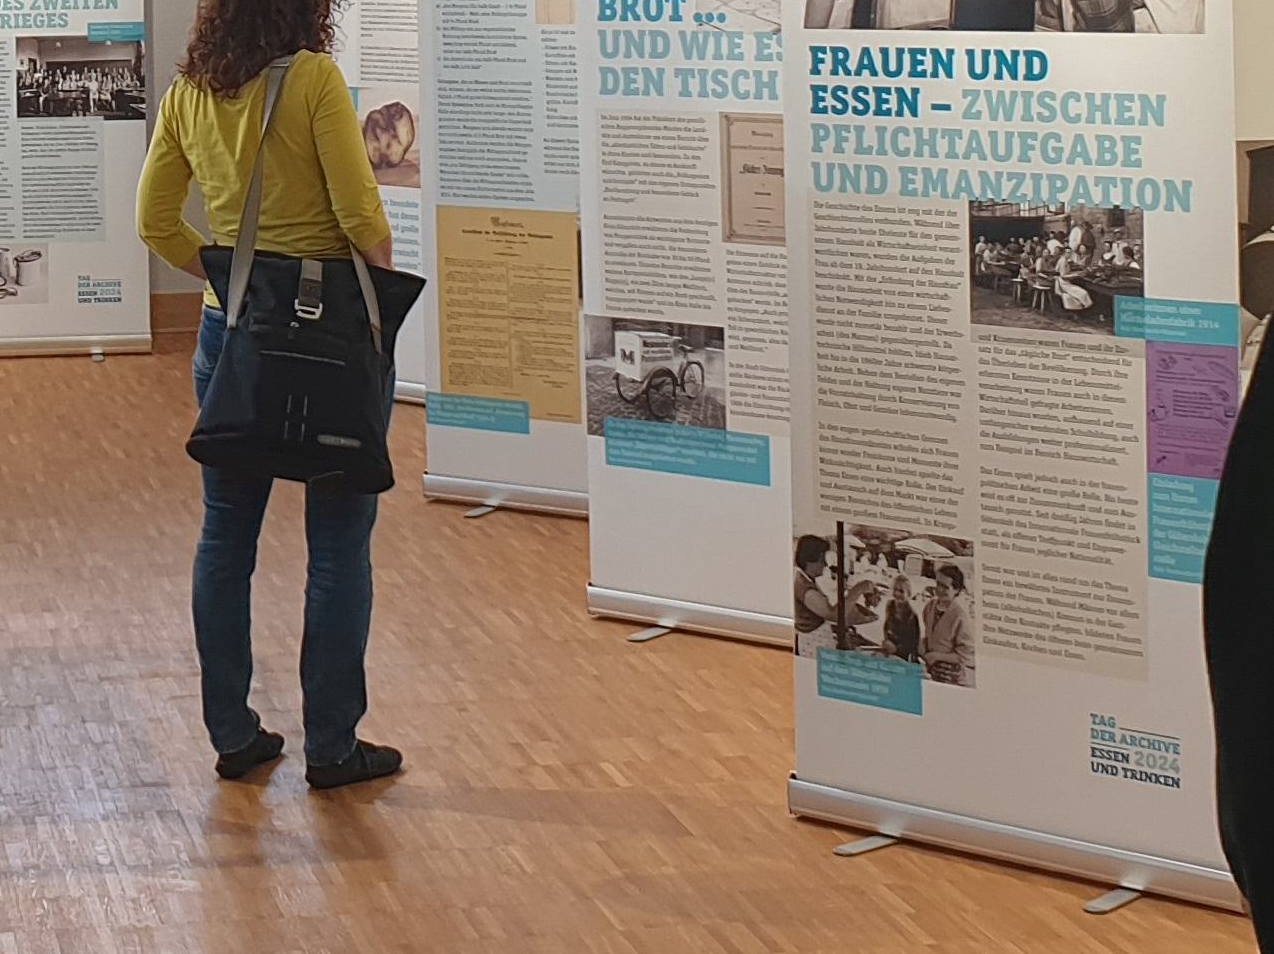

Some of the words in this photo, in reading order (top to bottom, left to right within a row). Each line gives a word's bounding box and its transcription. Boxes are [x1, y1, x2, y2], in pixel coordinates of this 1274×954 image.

[598, 30, 670, 59] UND
[679, 30, 744, 61] WIE
[809, 46, 955, 80] FRAUEN
[965, 49, 1048, 81] UND
[599, 66, 665, 96] DEN
[674, 68, 779, 100] TISCH
[810, 84, 920, 118] ESSEN
[961, 89, 1167, 126] ZWISCHEN
[810, 123, 1143, 168] PFLICHTAUFGABE
[811, 162, 888, 196] UND
[898, 166, 1192, 213] EMANZIPATION
[1090, 713, 1116, 728] TAG
[1090, 727, 1116, 743] DER
[1119, 733, 1180, 755] ARCHIVE
[1090, 747, 1129, 764] ESSEN
[1134, 751, 1180, 774] 2024
[1091, 761, 1118, 776] UND
[1121, 767, 1180, 788] TRINKEN
